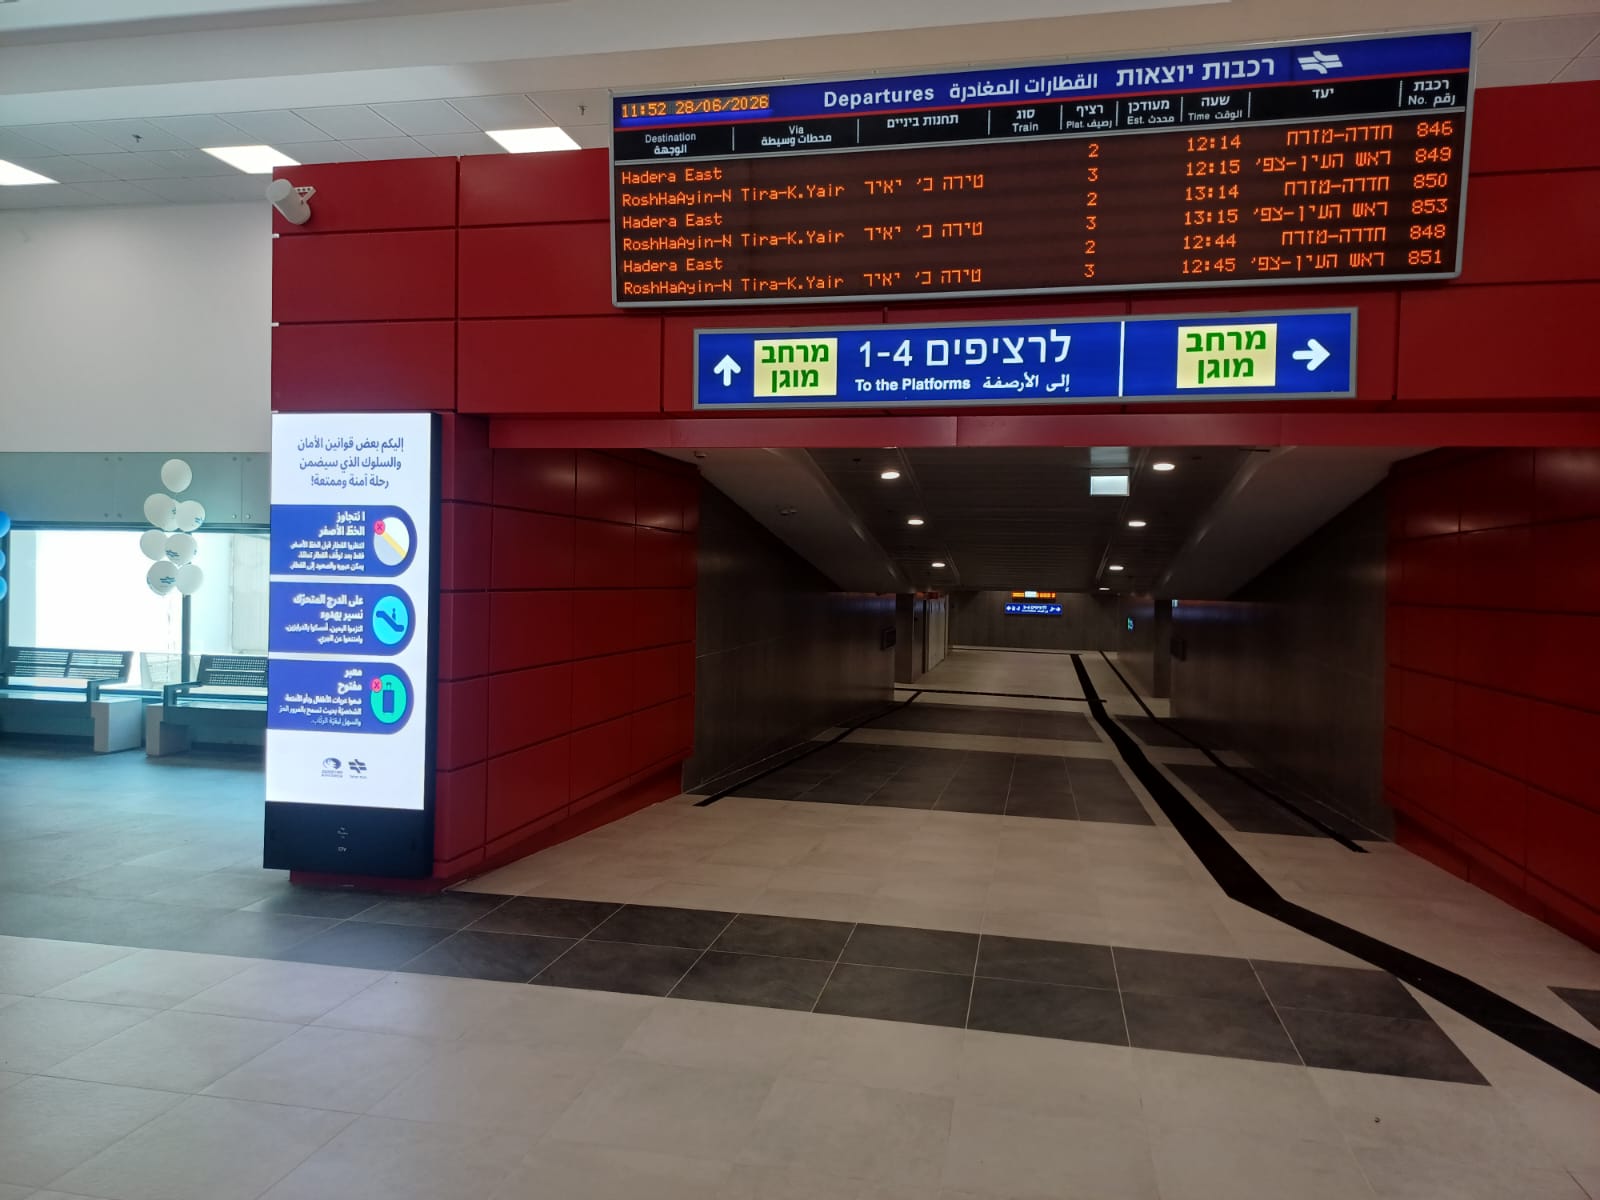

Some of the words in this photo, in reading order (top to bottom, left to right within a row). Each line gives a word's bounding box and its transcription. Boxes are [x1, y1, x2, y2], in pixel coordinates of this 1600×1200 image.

[1116, 64, 1193, 86] יוצאות
[1202, 58, 1275, 80] רכבות
[950, 79, 1019, 102] المغادرة
[1025, 74, 1098, 96] القطارات
[1312, 87, 1335, 99] יעד
[1413, 79, 1450, 91] רכבת
[824, 88, 934, 109] Departures
[1127, 99, 1171, 114] מעודכן
[1201, 95, 1231, 107] שעה
[1408, 95, 1427, 106] No.
[1433, 93, 1456, 108] رقم
[621, 101, 667, 118] 11:52
[1016, 109, 1036, 120] סוג
[1076, 104, 1104, 118] רציף
[1188, 112, 1211, 121] Time
[1214, 109, 1242, 121] الوقت
[887, 116, 919, 128] ביניים
[922, 114, 959, 127] תחנות
[1012, 122, 1039, 133] Train
[1066, 120, 1085, 129] Plat.
[1087, 119, 1113, 129] رصيف
[1127, 116, 1145, 125] Est.
[1148, 115, 1175, 124] محدث
[788, 125, 804, 135] Via
[1286, 124, 1393, 146] חדרה-מזרח
[1416, 121, 1453, 138] 846
[645, 132, 697, 144] Destination
[761, 135, 796, 147] وسيطة
[797, 133, 832, 144] محطات
[1187, 134, 1241, 152] 12:14
[653, 144, 687, 157] الوجهة
[1088, 143, 1099, 158] 2
[1355, 150, 1391, 167] ראש
[1414, 146, 1452, 164] 849
[622, 171, 676, 185] Hadera
[685, 167, 722, 182] East
[1087, 167, 1098, 182] 3
[1186, 159, 1240, 177] 12:15
[864, 179, 902, 195] יאיר
[942, 174, 984, 191] טירה
[1284, 176, 1390, 196] חדרה-מזרח
[1413, 173, 1448, 189] 850
[622, 189, 732, 207] RoshHaAyin-N
[741, 184, 845, 201] Tira-K.Yair
[1087, 192, 1098, 206] 2
[1185, 184, 1239, 201] 13:14
[1352, 201, 1388, 218] ראש
[1411, 199, 1448, 215] 853
[622, 215, 677, 229] Hadera
[685, 212, 723, 227] East
[1086, 215, 1097, 230] 3
[1184, 208, 1238, 226] 13:15
[863, 226, 901, 241] יאיר
[941, 221, 983, 238] טירה
[1281, 226, 1386, 246] חדרה-מזרח
[1409, 224, 1446, 240] 848
[623, 234, 732, 251] RoshHaAyin-N
[741, 230, 845, 247] Tira-K.Yair
[1085, 239, 1096, 254] 2
[1183, 233, 1237, 250] 12:44
[623, 259, 678, 273] Hadera
[686, 257, 723, 271] East
[1349, 251, 1385, 268] ראש
[1408, 249, 1441, 265] 851
[1084, 263, 1095, 278] 3
[1182, 257, 1236, 274] 12:45
[741, 276, 844, 291] Tira-K.Yair
[863, 272, 900, 287] יאיר
[940, 268, 981, 284] טירה
[624, 279, 732, 295] RoshHaAyin-N
[926, 328, 1072, 366] לרציפים
[1186, 330, 1267, 352] מרחב
[761, 344, 829, 363] מרחב
[859, 339, 913, 367] 1-4
[1198, 357, 1254, 385] מוגן
[771, 369, 819, 393] מוגן
[855, 378, 872, 391] To
[875, 378, 898, 391] the
[902, 376, 971, 391] Platforms
[982, 371, 1039, 392] الأرصفة
[1046, 374, 1070, 392] إلى
[297, 435, 324, 452] الأمان
[325, 436, 354, 452] قوانين
[355, 437, 379, 452] بعض
[381, 436, 404, 453] إليكم
[299, 457, 338, 470] سيضمن
[340, 456, 360, 474] الذي
[361, 456, 402, 471] والسلوك
[311, 473, 347, 489] وممتعة!
[349, 473, 368, 487] آمنة
[369, 473, 389, 489] رحلة
[326, 594, 347, 609] الدرج
[348, 595, 364, 608] على
[343, 609, 364, 622] نسير
[337, 680, 363, 695] مفتوح
